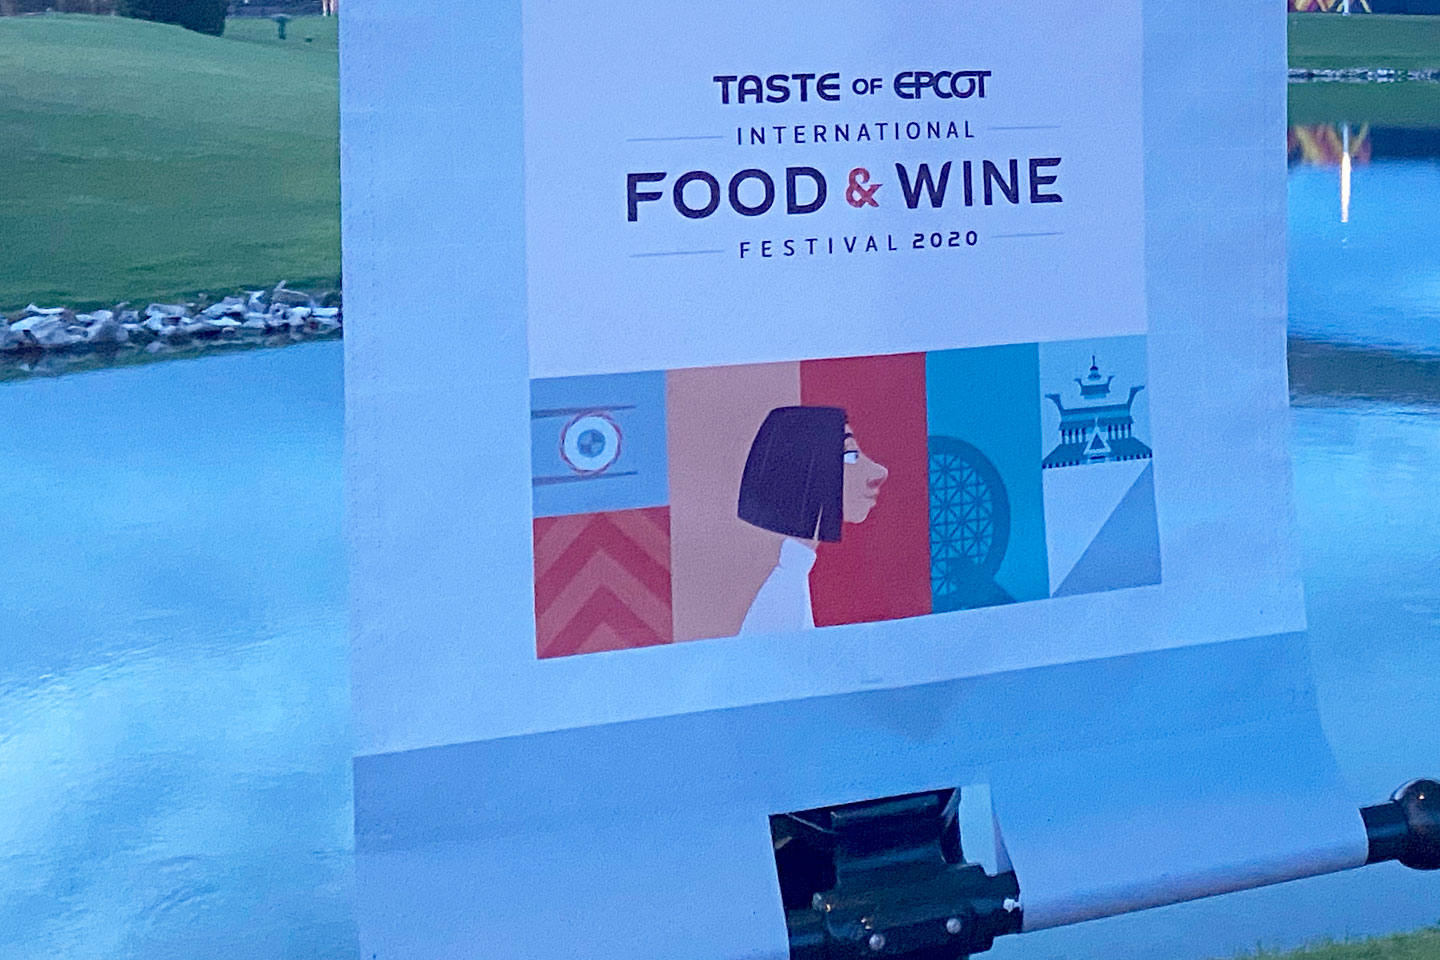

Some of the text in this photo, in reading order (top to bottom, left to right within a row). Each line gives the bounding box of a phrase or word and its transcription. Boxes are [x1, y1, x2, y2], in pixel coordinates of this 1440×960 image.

[712, 70, 992, 105] TASTE OF EPCOT
[737, 120, 975, 145] INTERNATIONAL
[626, 157, 1063, 222] FOOD & WINE
[739, 230, 979, 259] FESTIVAL 2020
